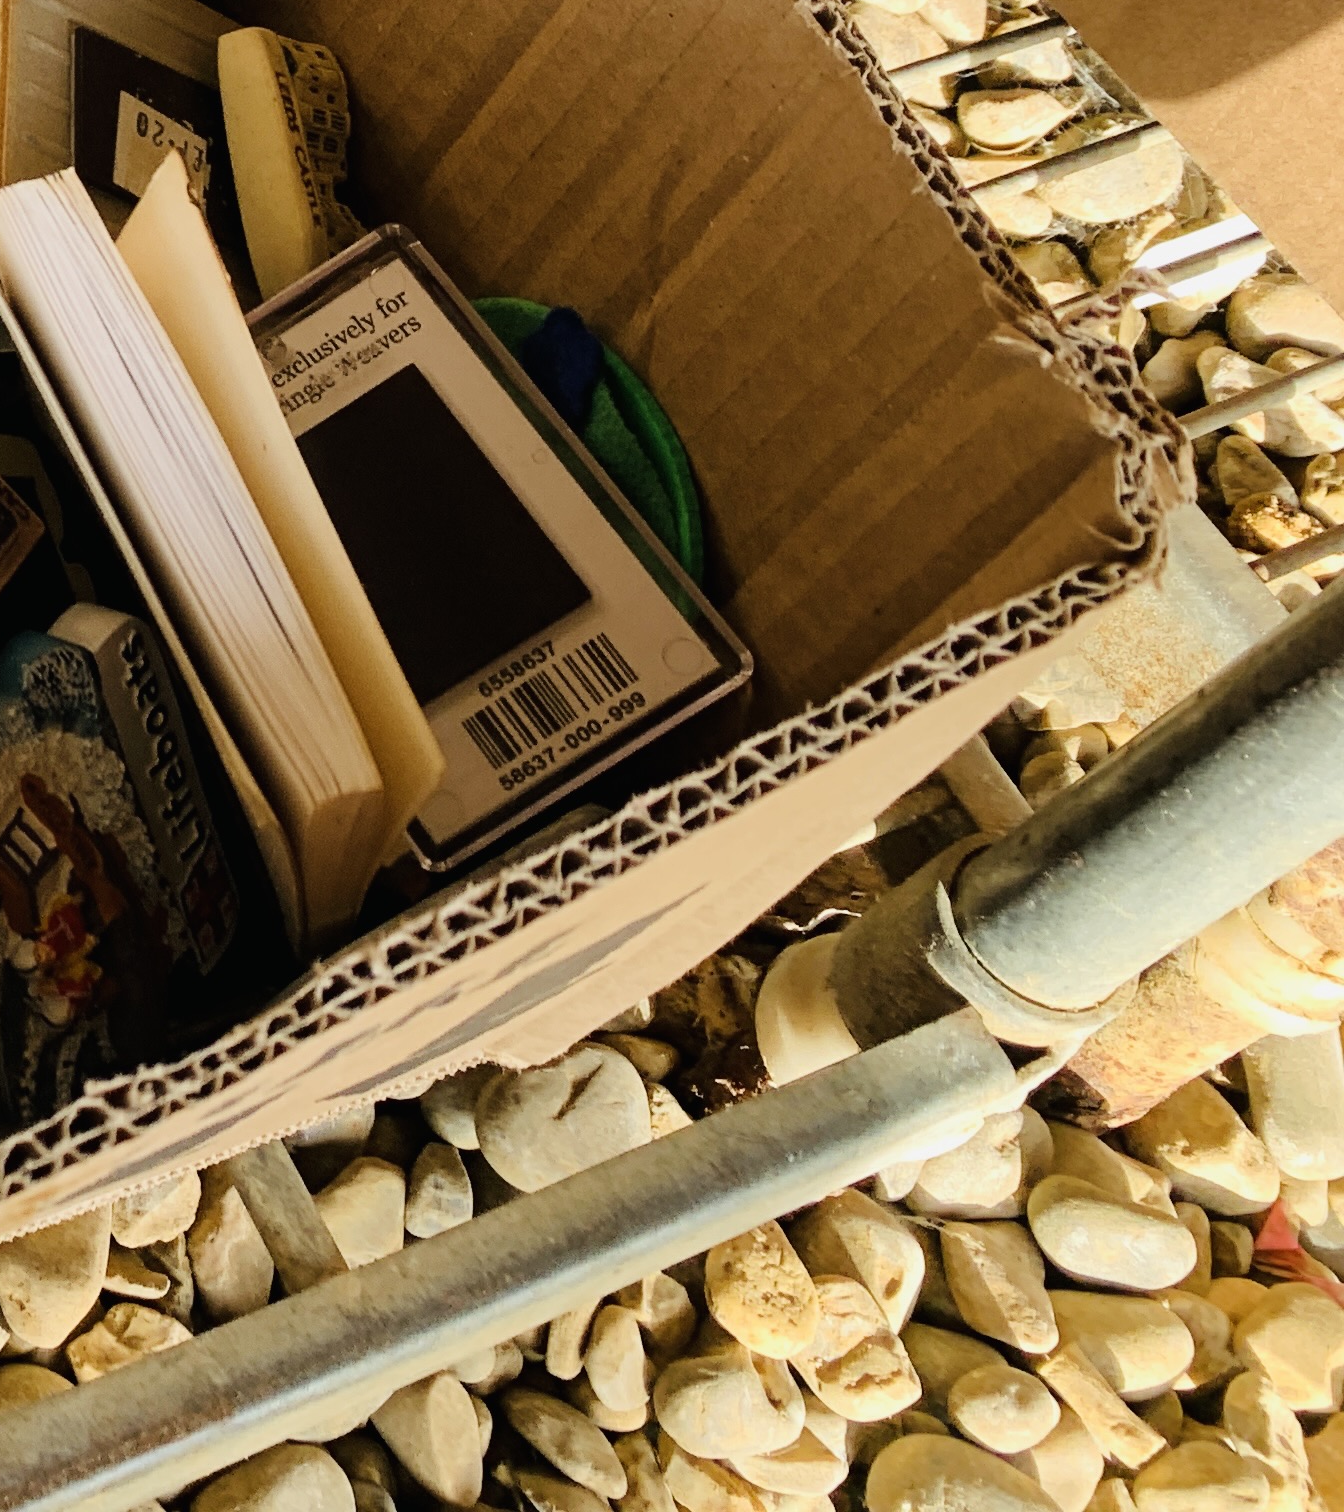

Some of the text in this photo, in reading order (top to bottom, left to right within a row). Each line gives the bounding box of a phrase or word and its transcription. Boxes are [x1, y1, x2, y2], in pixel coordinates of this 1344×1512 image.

[274, 71, 325, 229] LEEDS CASTLE
[270, 287, 412, 390] exclusively for
[477, 640, 558, 700] 6558637
[122, 630, 210, 863] Lifeboats
[497, 689, 649, 792] 58637-000-999
